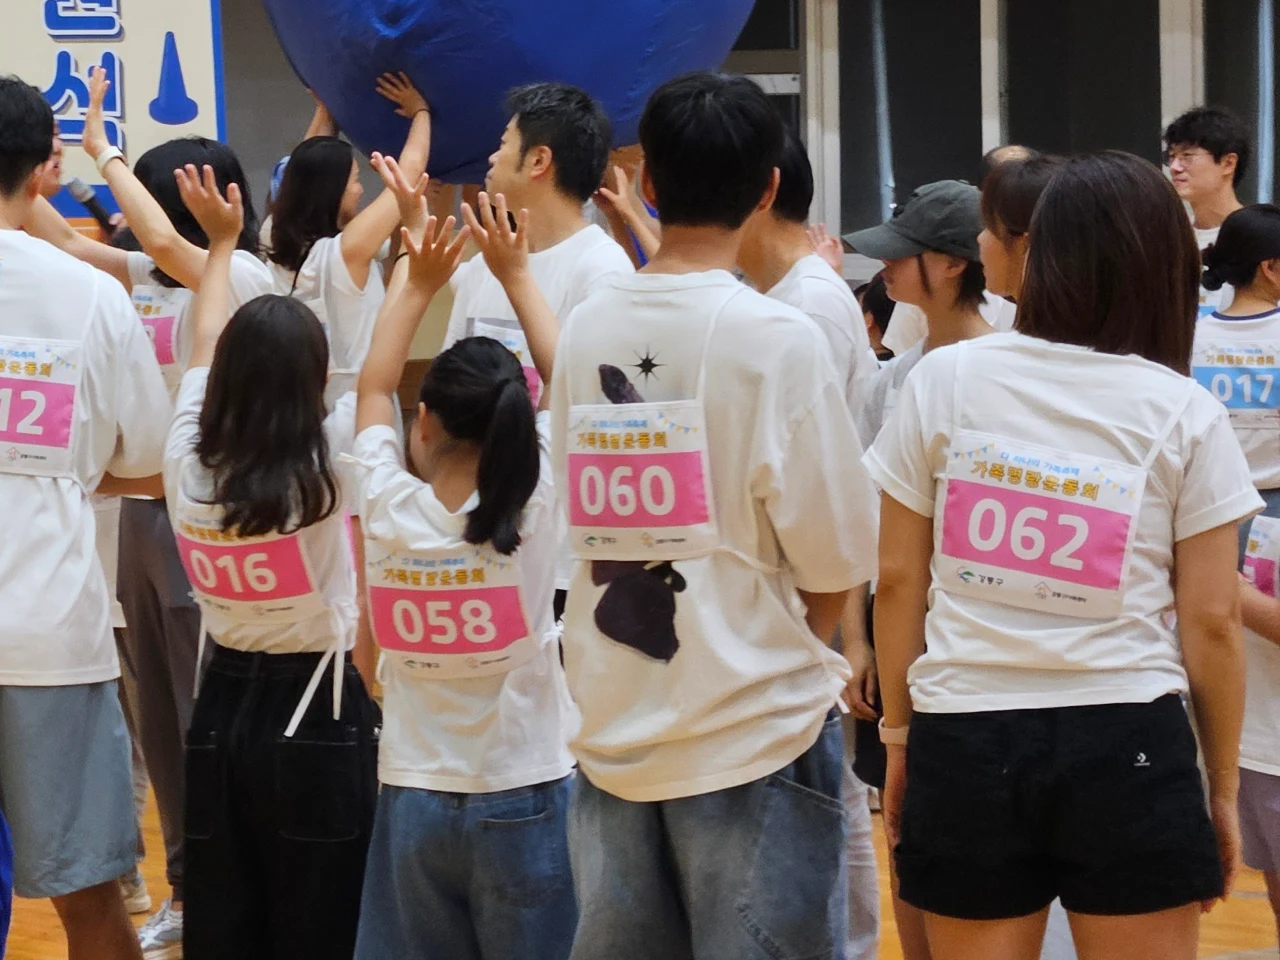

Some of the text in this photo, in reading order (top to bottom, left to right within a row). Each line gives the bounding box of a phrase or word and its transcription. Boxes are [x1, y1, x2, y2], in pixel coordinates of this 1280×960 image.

[1211, 373, 1274, 403] 017
[579, 465, 676, 517] 060
[970, 459, 1101, 502] 가족명랑운동회
[967, 497, 1090, 571] 062
[189, 548, 277, 593] 016
[392, 598, 498, 645] 058
